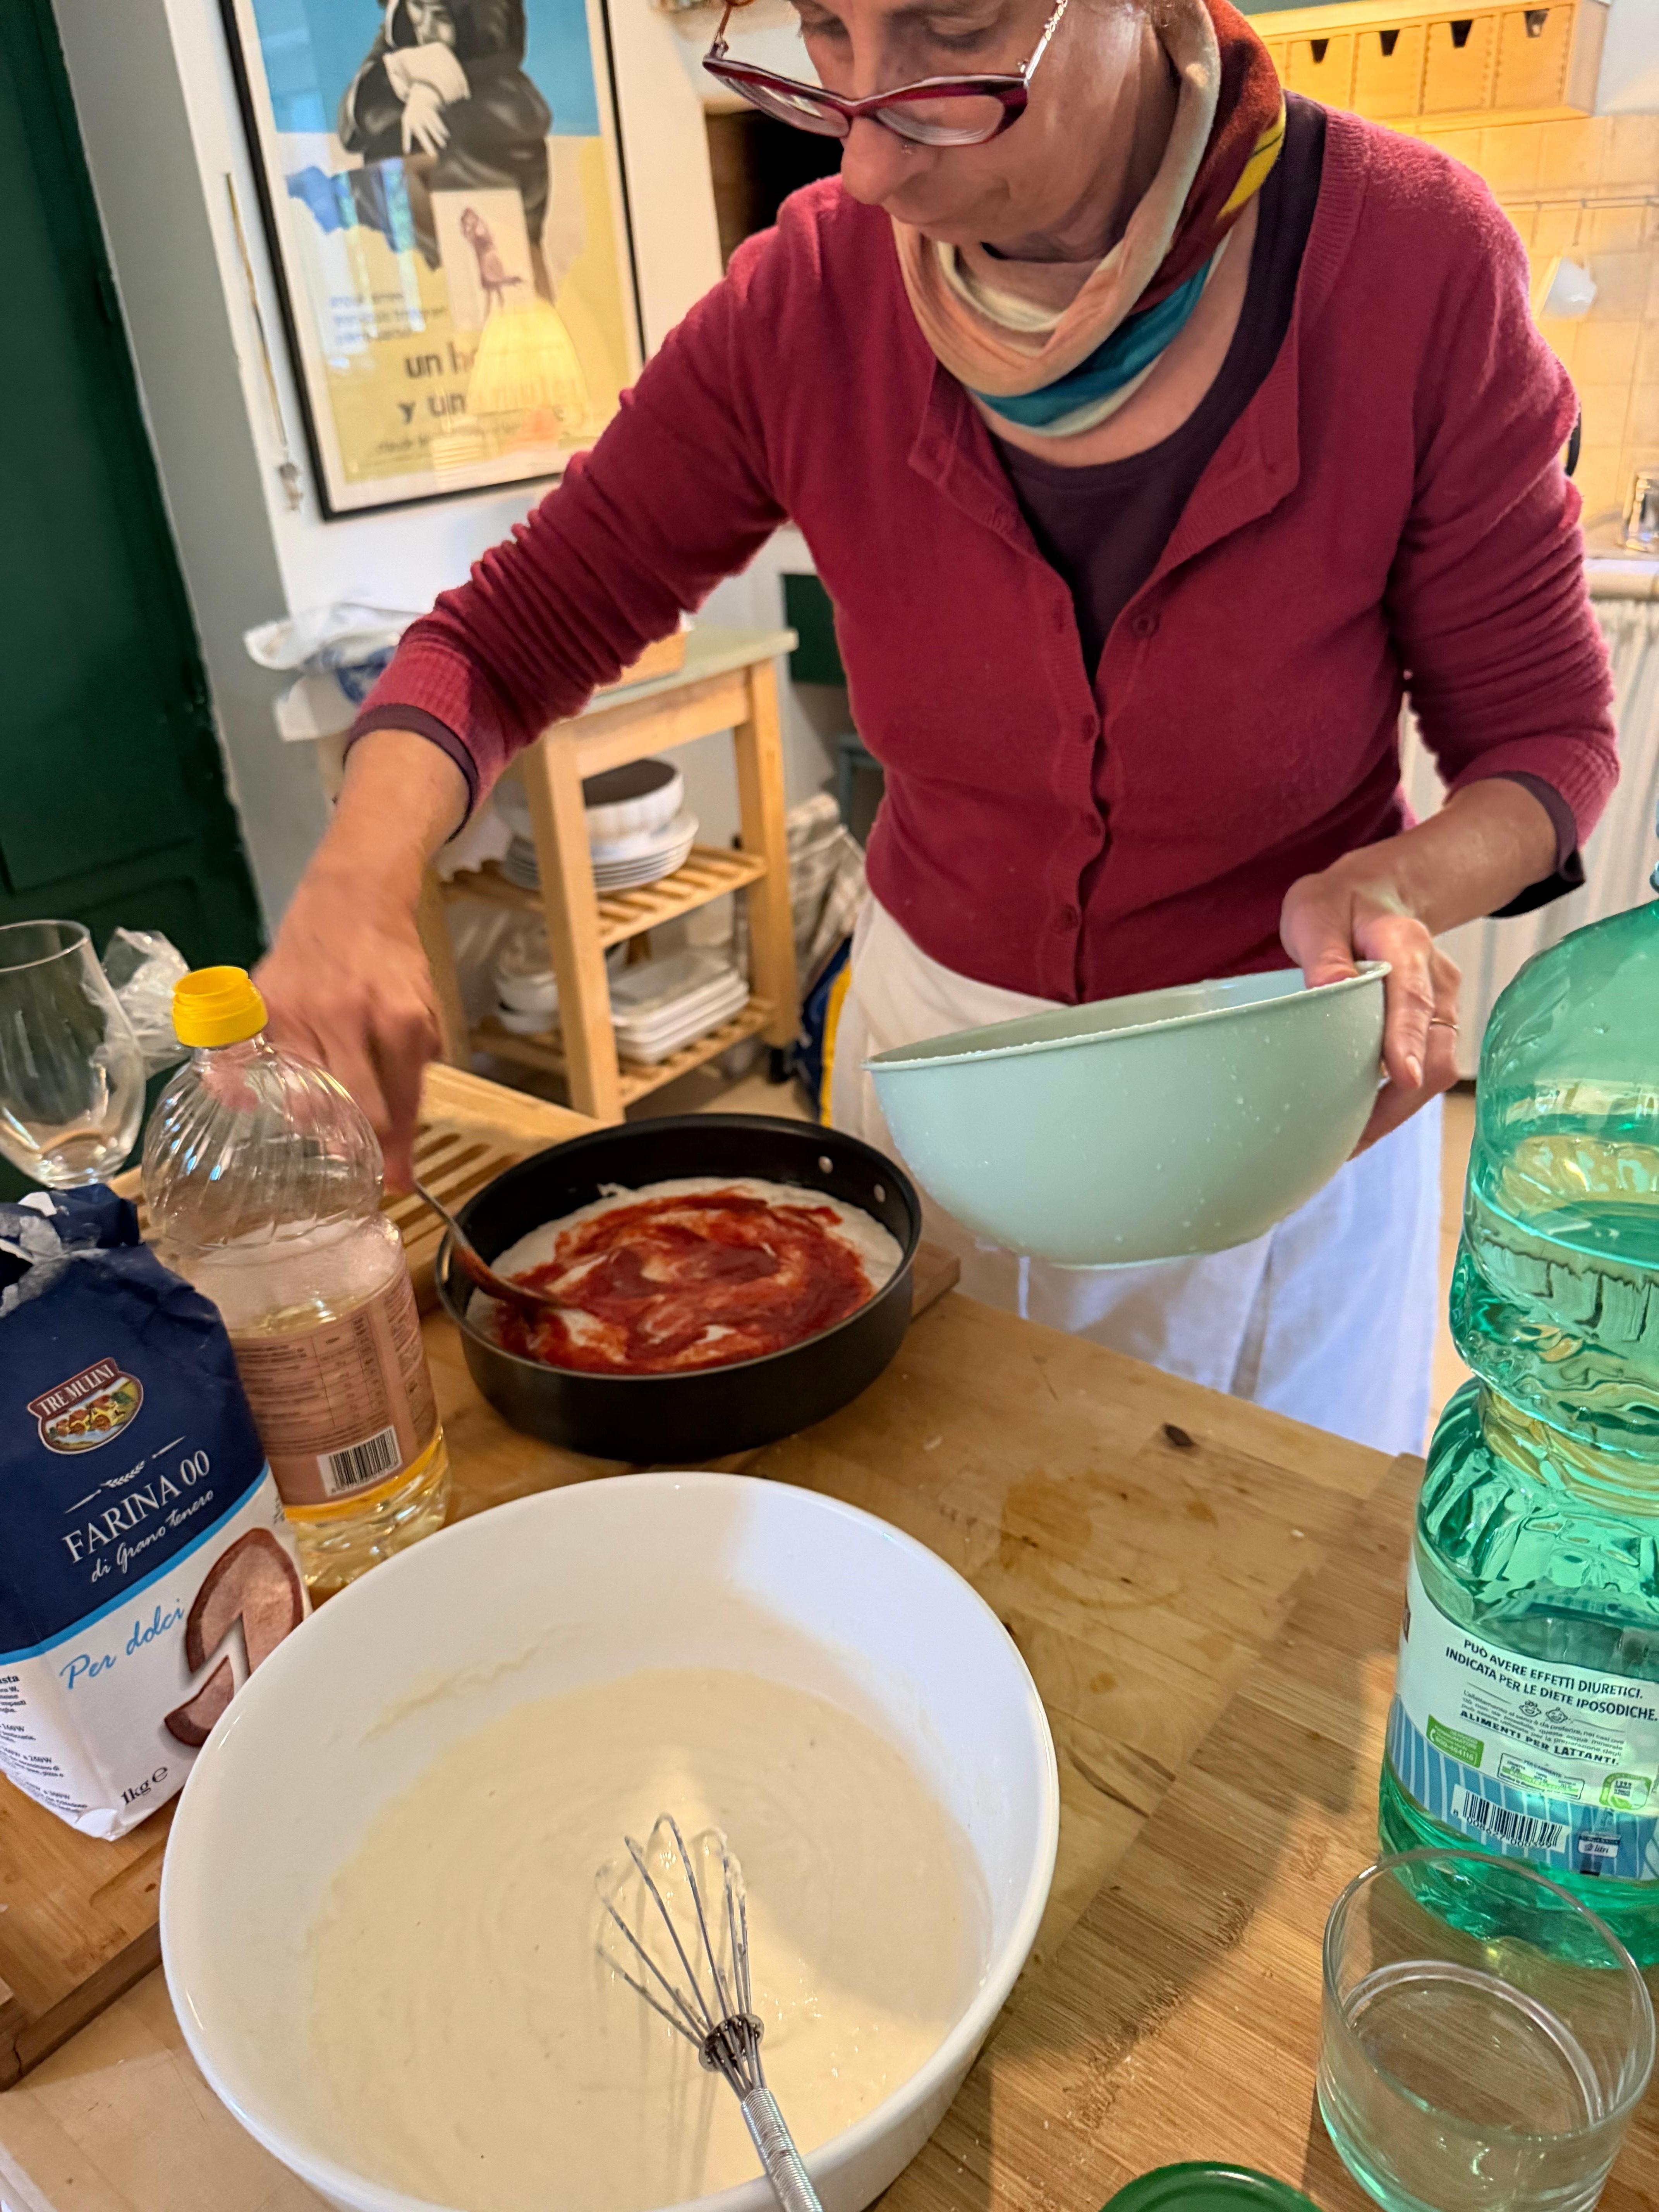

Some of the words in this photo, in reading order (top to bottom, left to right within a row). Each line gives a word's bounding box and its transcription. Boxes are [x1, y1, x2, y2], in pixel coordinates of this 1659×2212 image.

[405, 354, 444, 379] un
[397, 400, 416, 424] y
[37, 1391, 69, 1415] TRE
[64, 1364, 115, 1401] MULINI
[62, 1474, 182, 1563] FARINA
[180, 1450, 210, 1486] 00
[91, 1558, 111, 1583] di
[117, 1526, 166, 1573] Grano
[165, 1490, 214, 1528] tenero
[59, 1654, 117, 1690] Per
[126, 1598, 184, 1656] dolci
[1464, 1638, 1488, 1658] PUÒ
[1489, 1654, 1527, 1676] AVERE
[1530, 1668, 1575, 1690] EFFETTI
[1578, 1680, 1643, 1699] DIURETICI.
[1445, 1646, 1497, 1680] INDICATA
[1498, 1673, 1521, 1692] PER
[1523, 1683, 1537, 1695] LE
[1540, 1687, 1574, 1705] DIETE
[1576, 1698, 1658, 1721] IPOSODICHE.
[1460, 1710, 1521, 1739] ALIMENTI
[1525, 1735, 1549, 1751] PER
[1554, 1745, 1619, 1765] LATTANTI.
[120, 1779, 151, 1805] 1kg
[1594, 1844, 1609, 1853] litri
